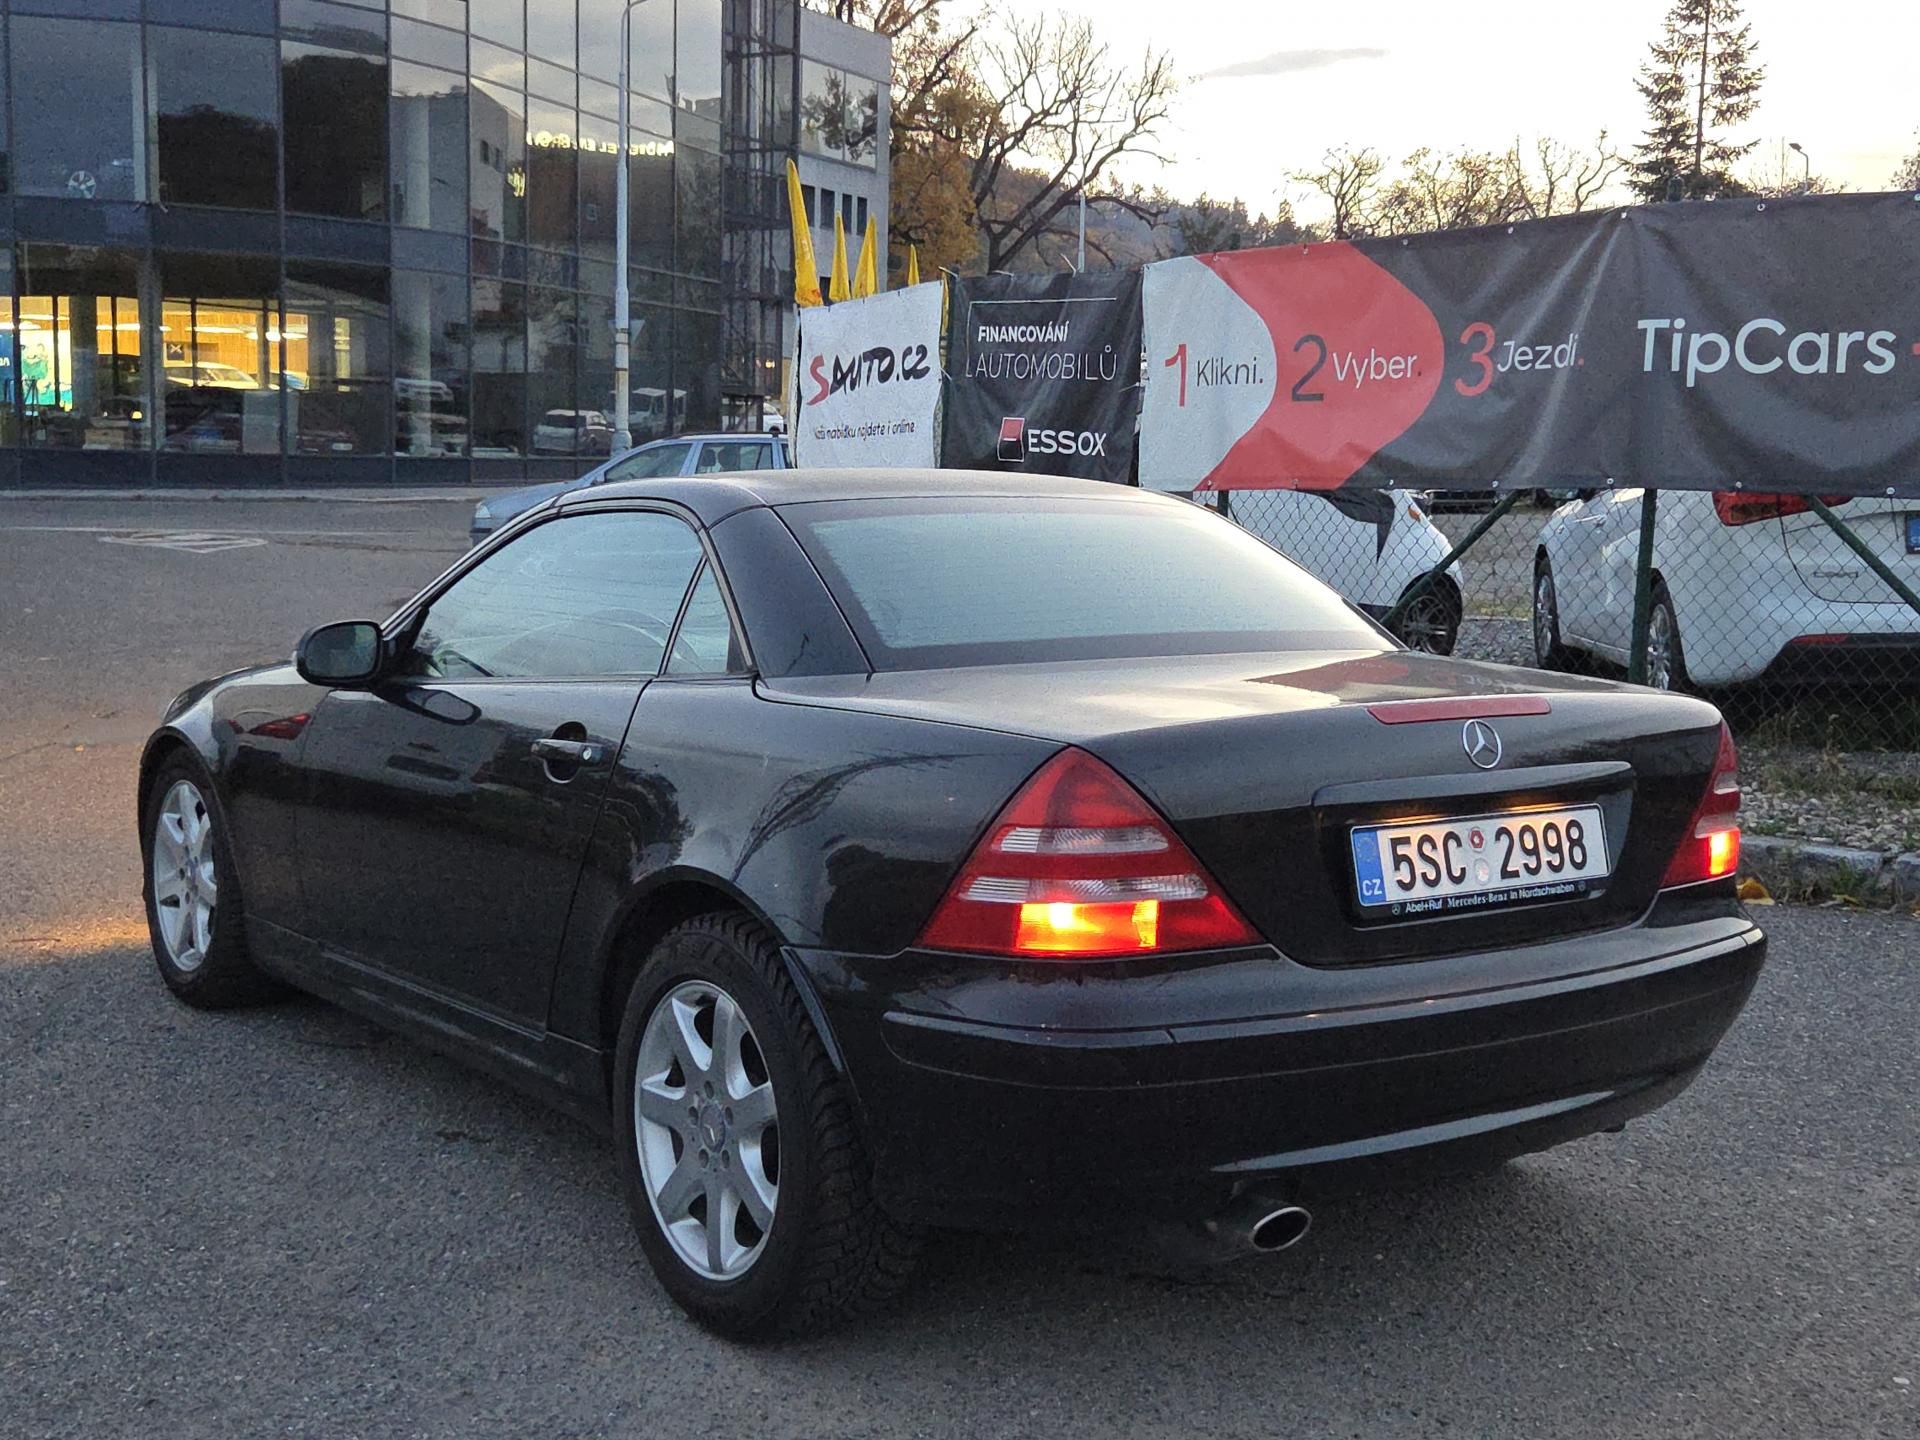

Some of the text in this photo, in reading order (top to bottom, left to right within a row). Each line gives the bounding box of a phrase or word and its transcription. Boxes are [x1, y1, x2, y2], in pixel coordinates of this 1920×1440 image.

[977, 320, 1070, 343] FINANCOVÁNÍ
[975, 345, 1118, 381] AUTOMOBILŮ
[1164, 321, 1585, 408] 1 Klikni. 2 Vyber. 3 Jezdi.
[1637, 317, 1897, 388] TipCars
[1027, 429, 1107, 457] ESSOX
[1388, 818, 1588, 892] 5SC 2998
[1362, 878, 1382, 896] CZ
[1447, 893, 1508, 910] Mercedes-Benz
[1510, 889, 1518, 900] in
[1519, 883, 1576, 899] Nordschwaben
